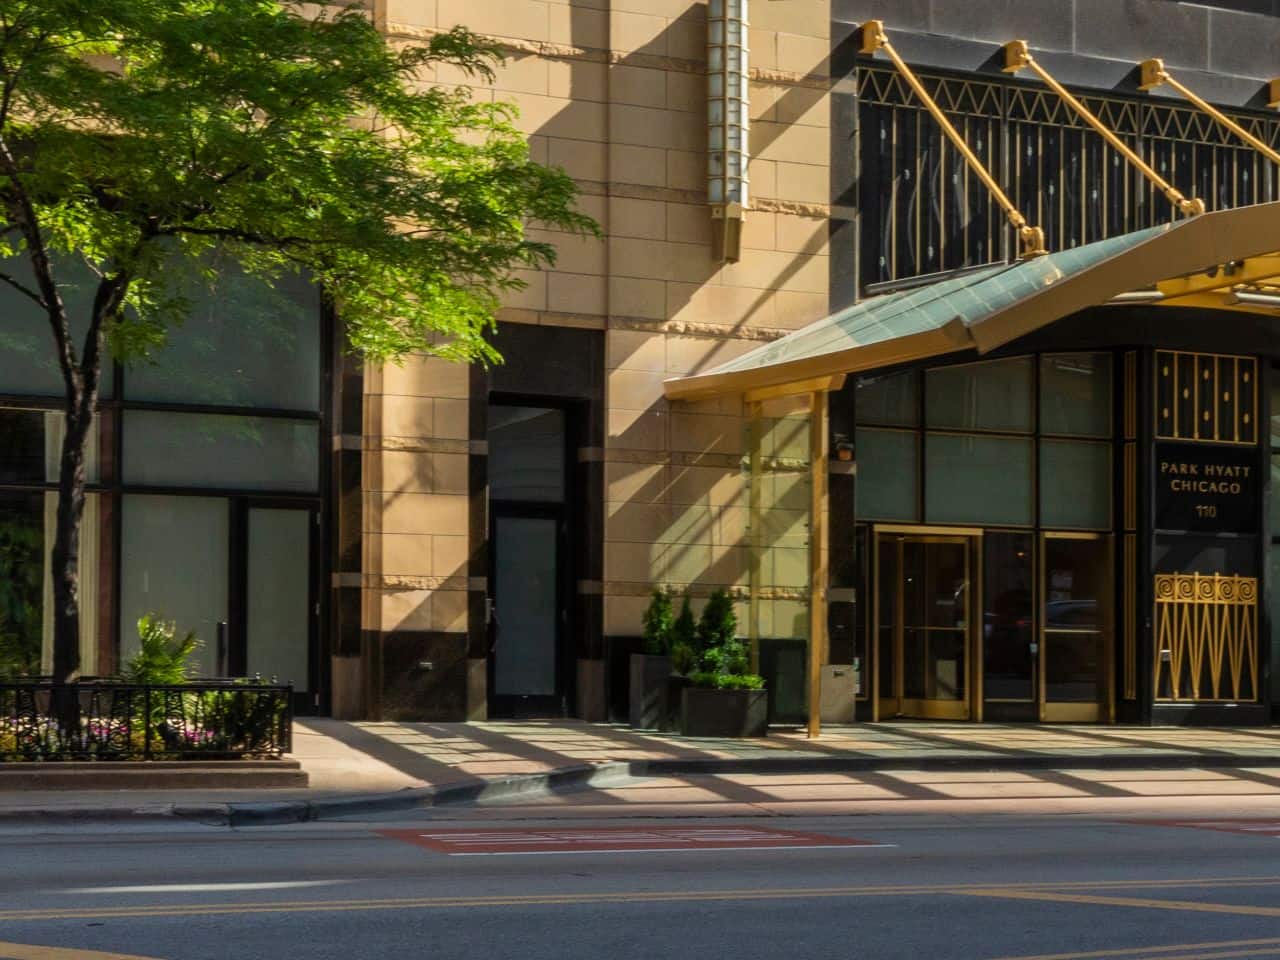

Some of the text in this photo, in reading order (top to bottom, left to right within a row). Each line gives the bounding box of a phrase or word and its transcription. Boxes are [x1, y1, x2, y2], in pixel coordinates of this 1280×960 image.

[1160, 461, 1250, 477] PARK HYATT
[1170, 479, 1241, 495] CHICAGO
